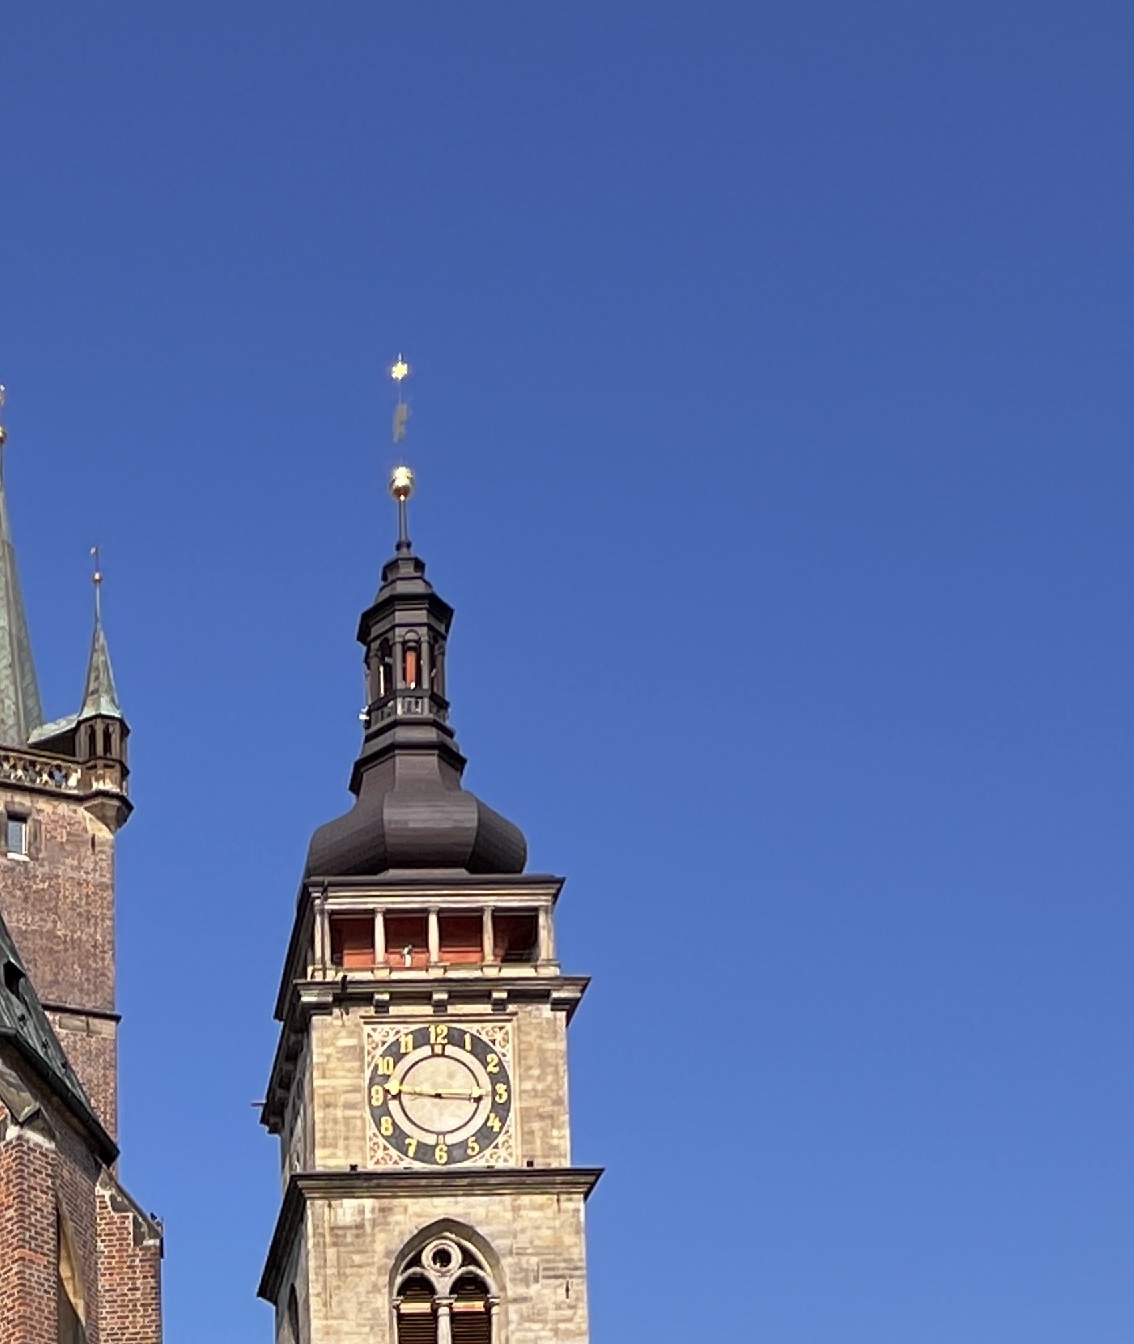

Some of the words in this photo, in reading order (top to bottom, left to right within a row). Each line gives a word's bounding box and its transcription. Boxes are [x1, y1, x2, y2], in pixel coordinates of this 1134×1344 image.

[399, 1033, 413, 1053] 11
[429, 1025, 448, 1044] 12
[464, 1033, 472, 1052] 1
[376, 1056, 394, 1075] 10
[486, 1053, 499, 1073] 2
[371, 1084, 384, 1107] 9
[494, 1083, 508, 1104] 3
[380, 1116, 394, 1136] 8
[487, 1113, 501, 1132] 4
[405, 1137, 418, 1158] 7
[434, 1144, 448, 1164] 6
[466, 1137, 479, 1156] 5
